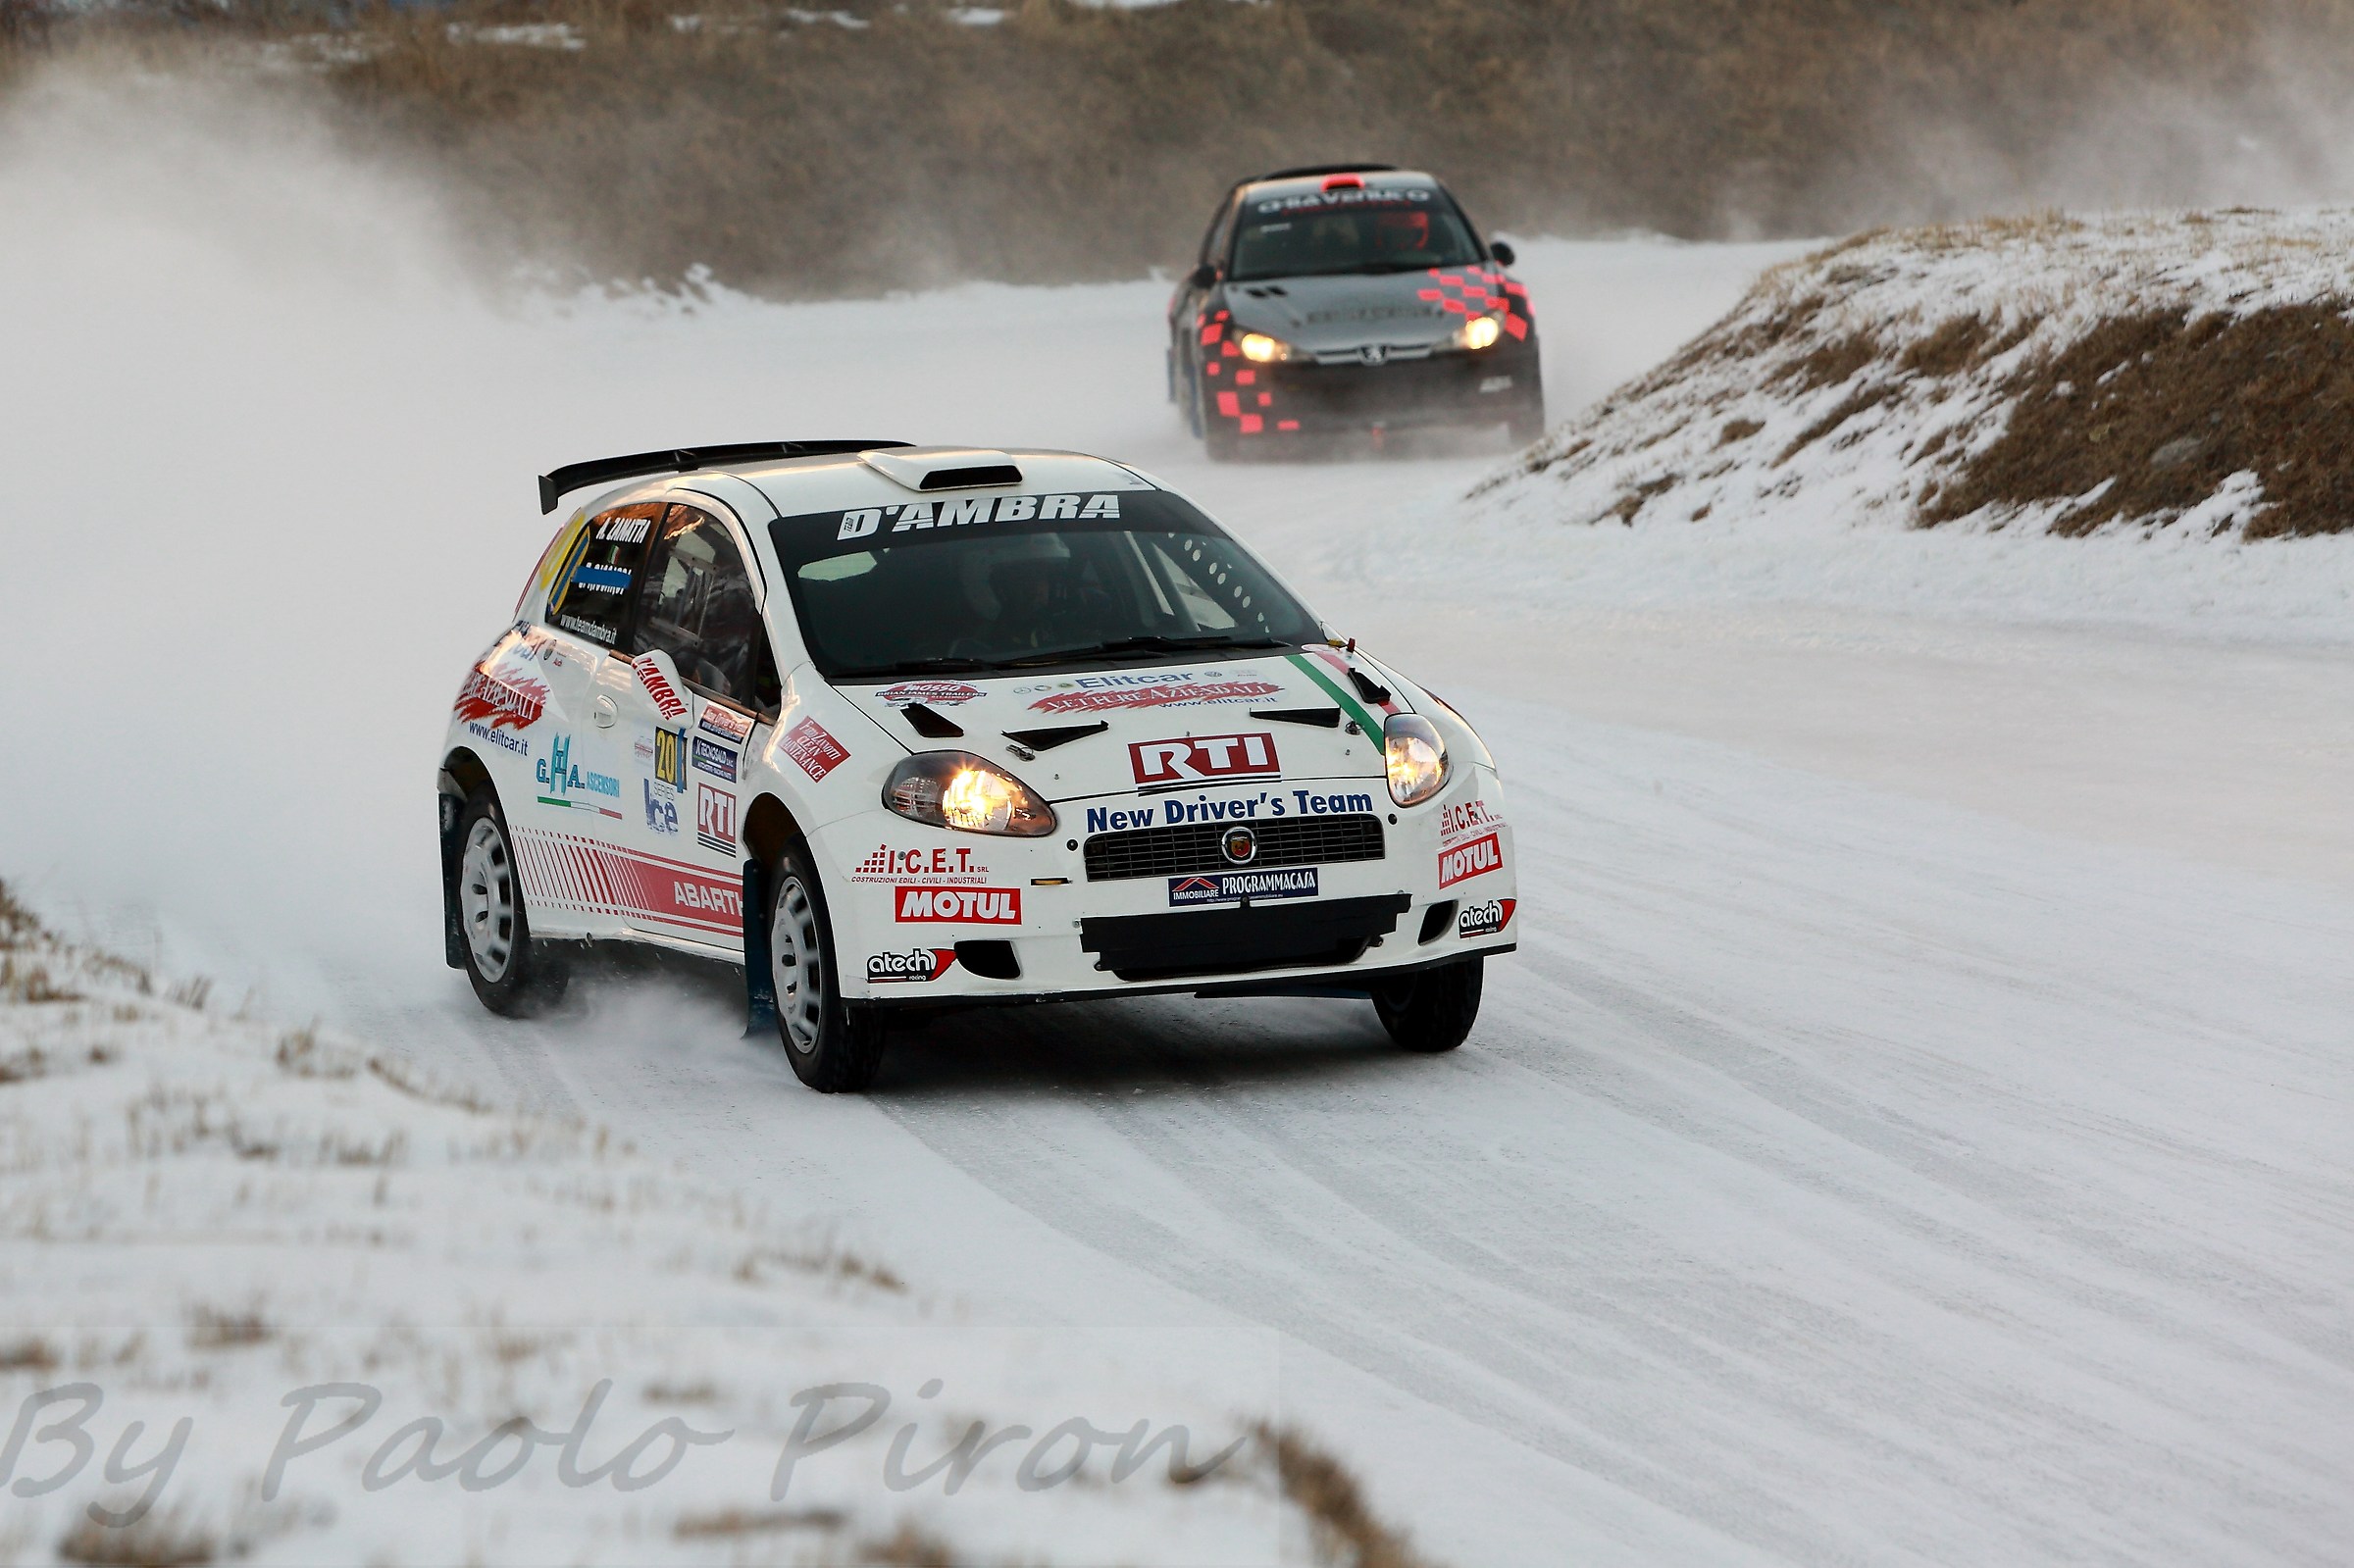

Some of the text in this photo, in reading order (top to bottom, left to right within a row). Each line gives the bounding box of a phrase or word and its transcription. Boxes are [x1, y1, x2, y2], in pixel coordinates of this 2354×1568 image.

[837, 494, 1121, 540] D'AMBRA
[1075, 672, 1193, 688] Elitcar
[1048, 685, 1266, 709] VETTURE AZIENDALI
[1158, 696, 1278, 708] www.elitcar.it
[469, 721, 529, 757] www.elitcar.it
[796, 735, 823, 757] CLEAN
[1139, 736, 1269, 779] RTI
[699, 786, 735, 837] RTI
[1087, 790, 1373, 833] New Driver's Team
[1441, 839, 1499, 884] MOTUL
[1173, 871, 1316, 900] IMMOBILIARE PROGRAMMACASA
[900, 890, 1016, 920] MOTUL
[1459, 899, 1501, 929] atech
[868, 949, 931, 973] atech
